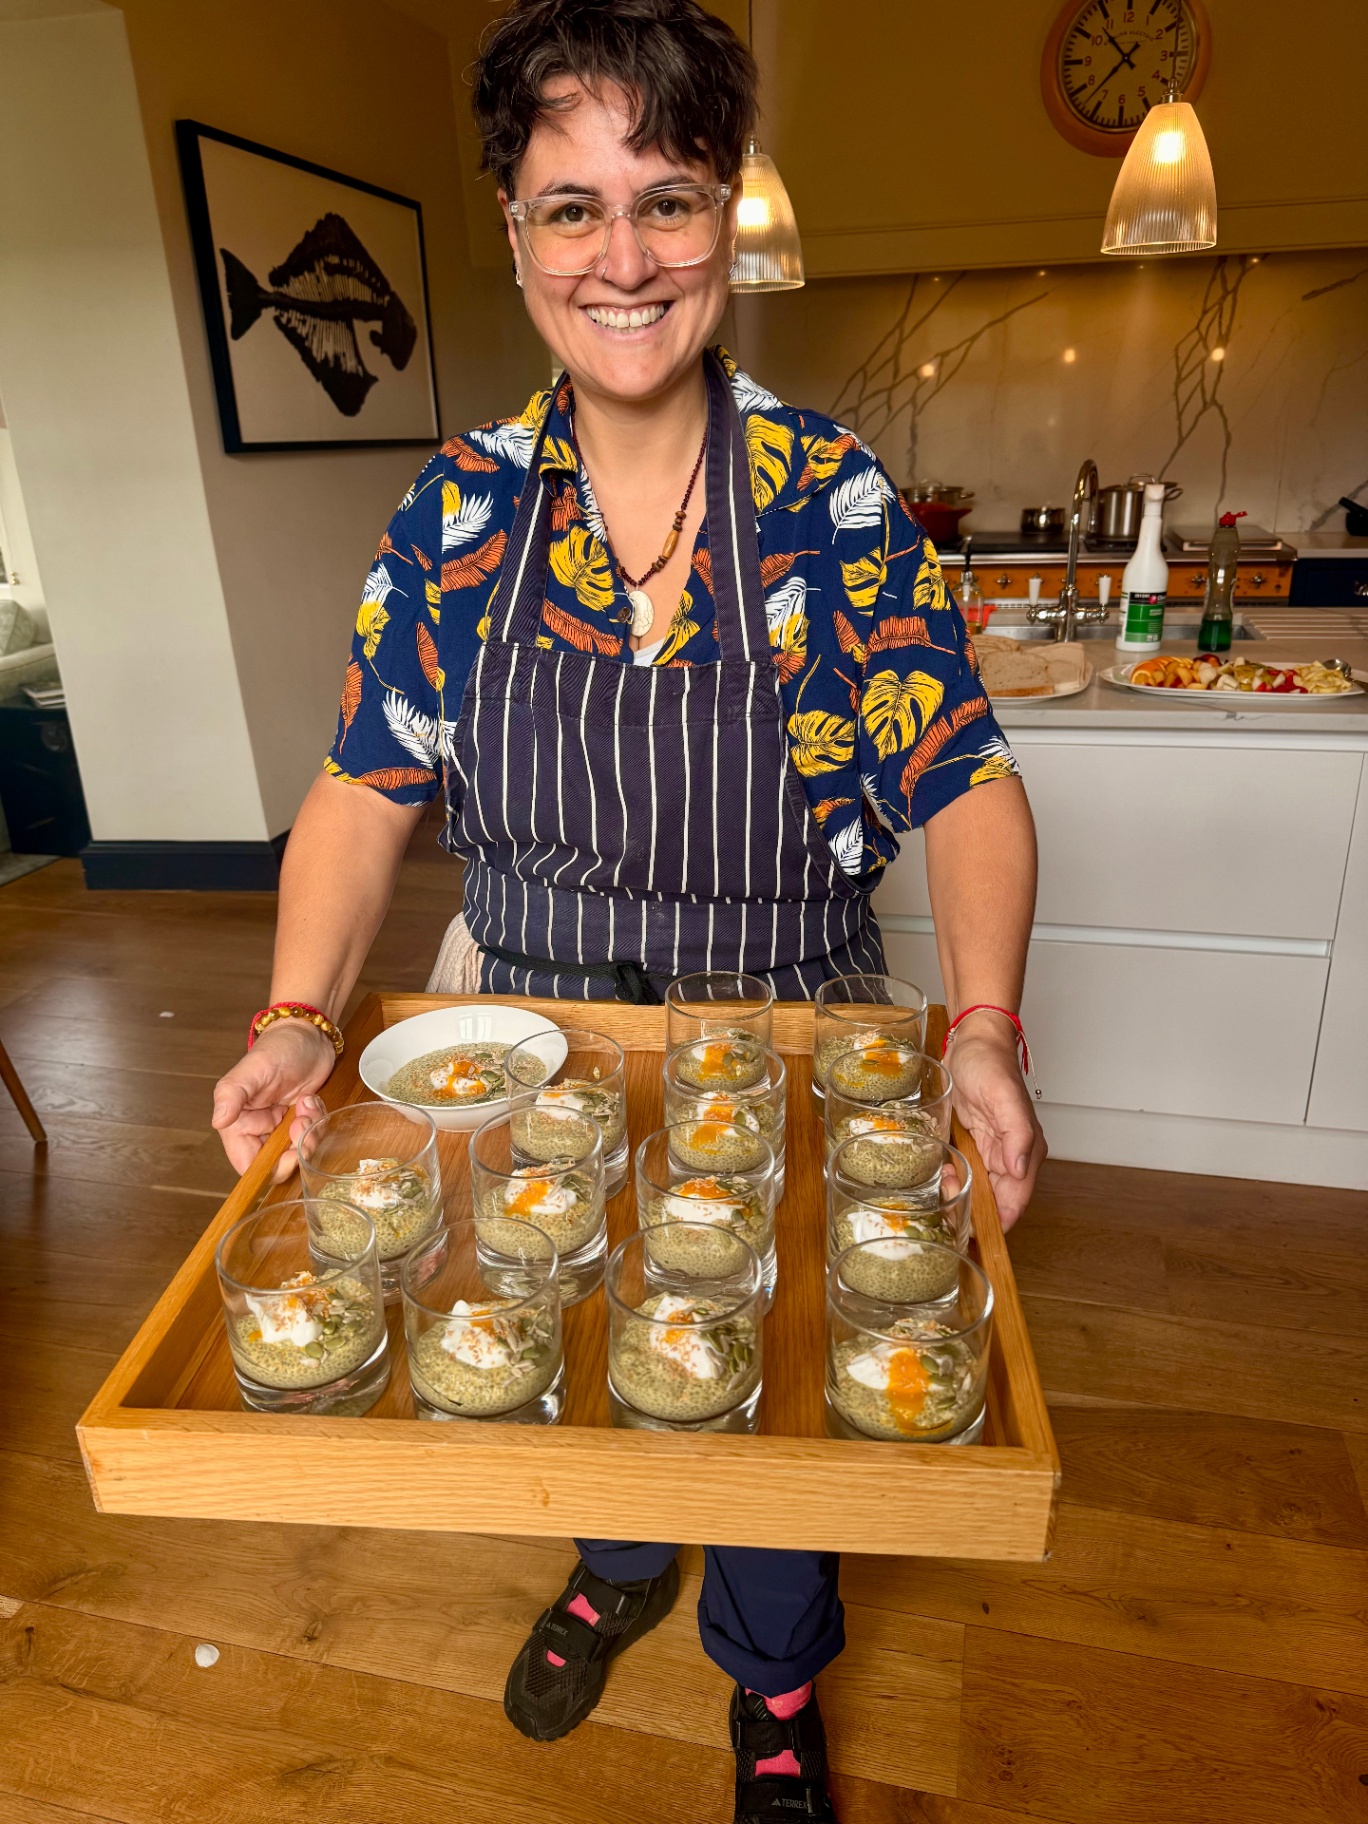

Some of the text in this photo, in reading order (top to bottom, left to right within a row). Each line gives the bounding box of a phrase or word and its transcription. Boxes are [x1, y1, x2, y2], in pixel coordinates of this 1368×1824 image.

[1123, 12, 1134, 23] 12
[1106, 19, 1114, 30] 11
[1155, 29, 1164, 40] 2
[1092, 35, 1103, 46] 10
[1084, 56, 1092, 66] 9
[1160, 50, 1168, 61] 3
[1088, 75, 1095, 86] 8
[1151, 70, 1160, 80] 4
[1102, 89, 1109, 100] 7
[1137, 86, 1145, 97] 5
[1118, 94, 1126, 105] 6
[782, 1798, 807, 1809] TERREX
